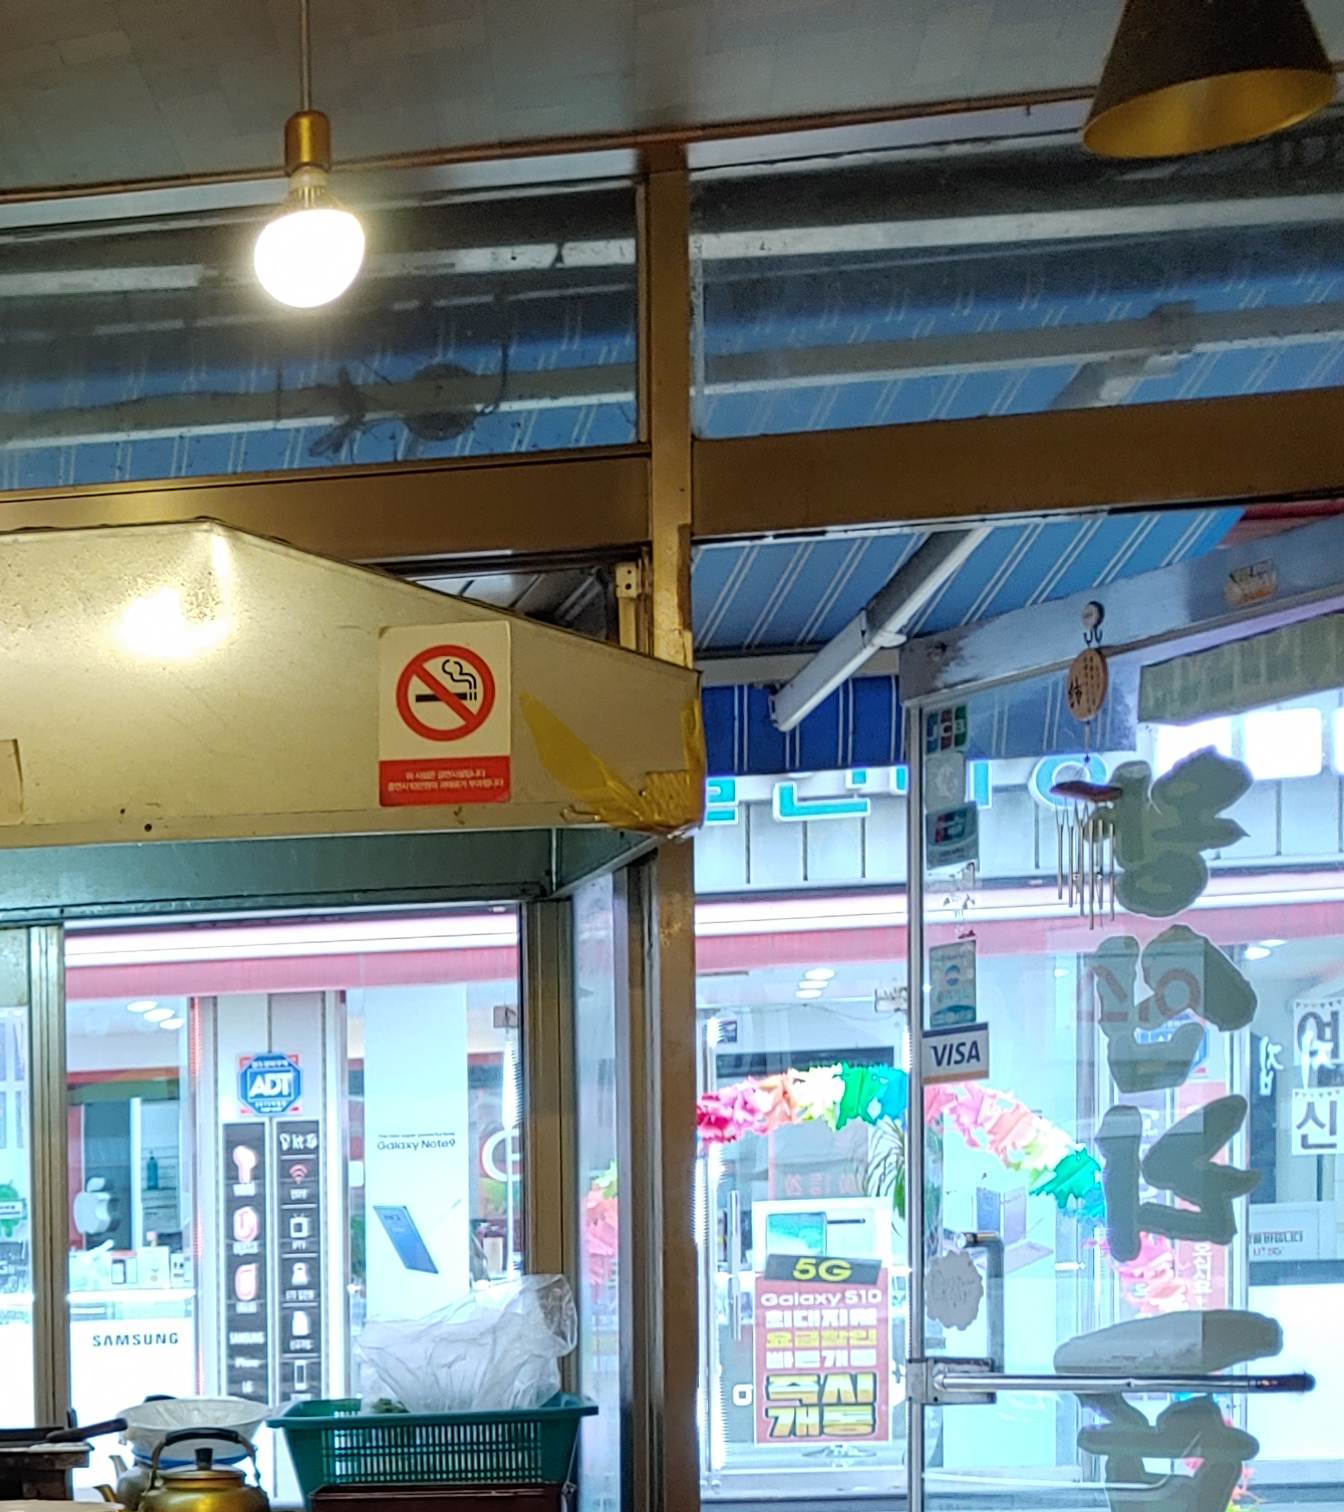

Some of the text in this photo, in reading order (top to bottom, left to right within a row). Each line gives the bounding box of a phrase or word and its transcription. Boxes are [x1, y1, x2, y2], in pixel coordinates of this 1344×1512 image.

[929, 1040, 981, 1069] VISA
[250, 1072, 293, 1097] ADT
[377, 1138, 456, 1151] Galaxy Note9
[792, 1257, 852, 1282] 5G
[761, 1289, 883, 1307] Galaxy S10
[92, 1331, 180, 1348] SAMSUNG
[766, 1372, 877, 1405] 즉시
[766, 1404, 877, 1438] 개통
